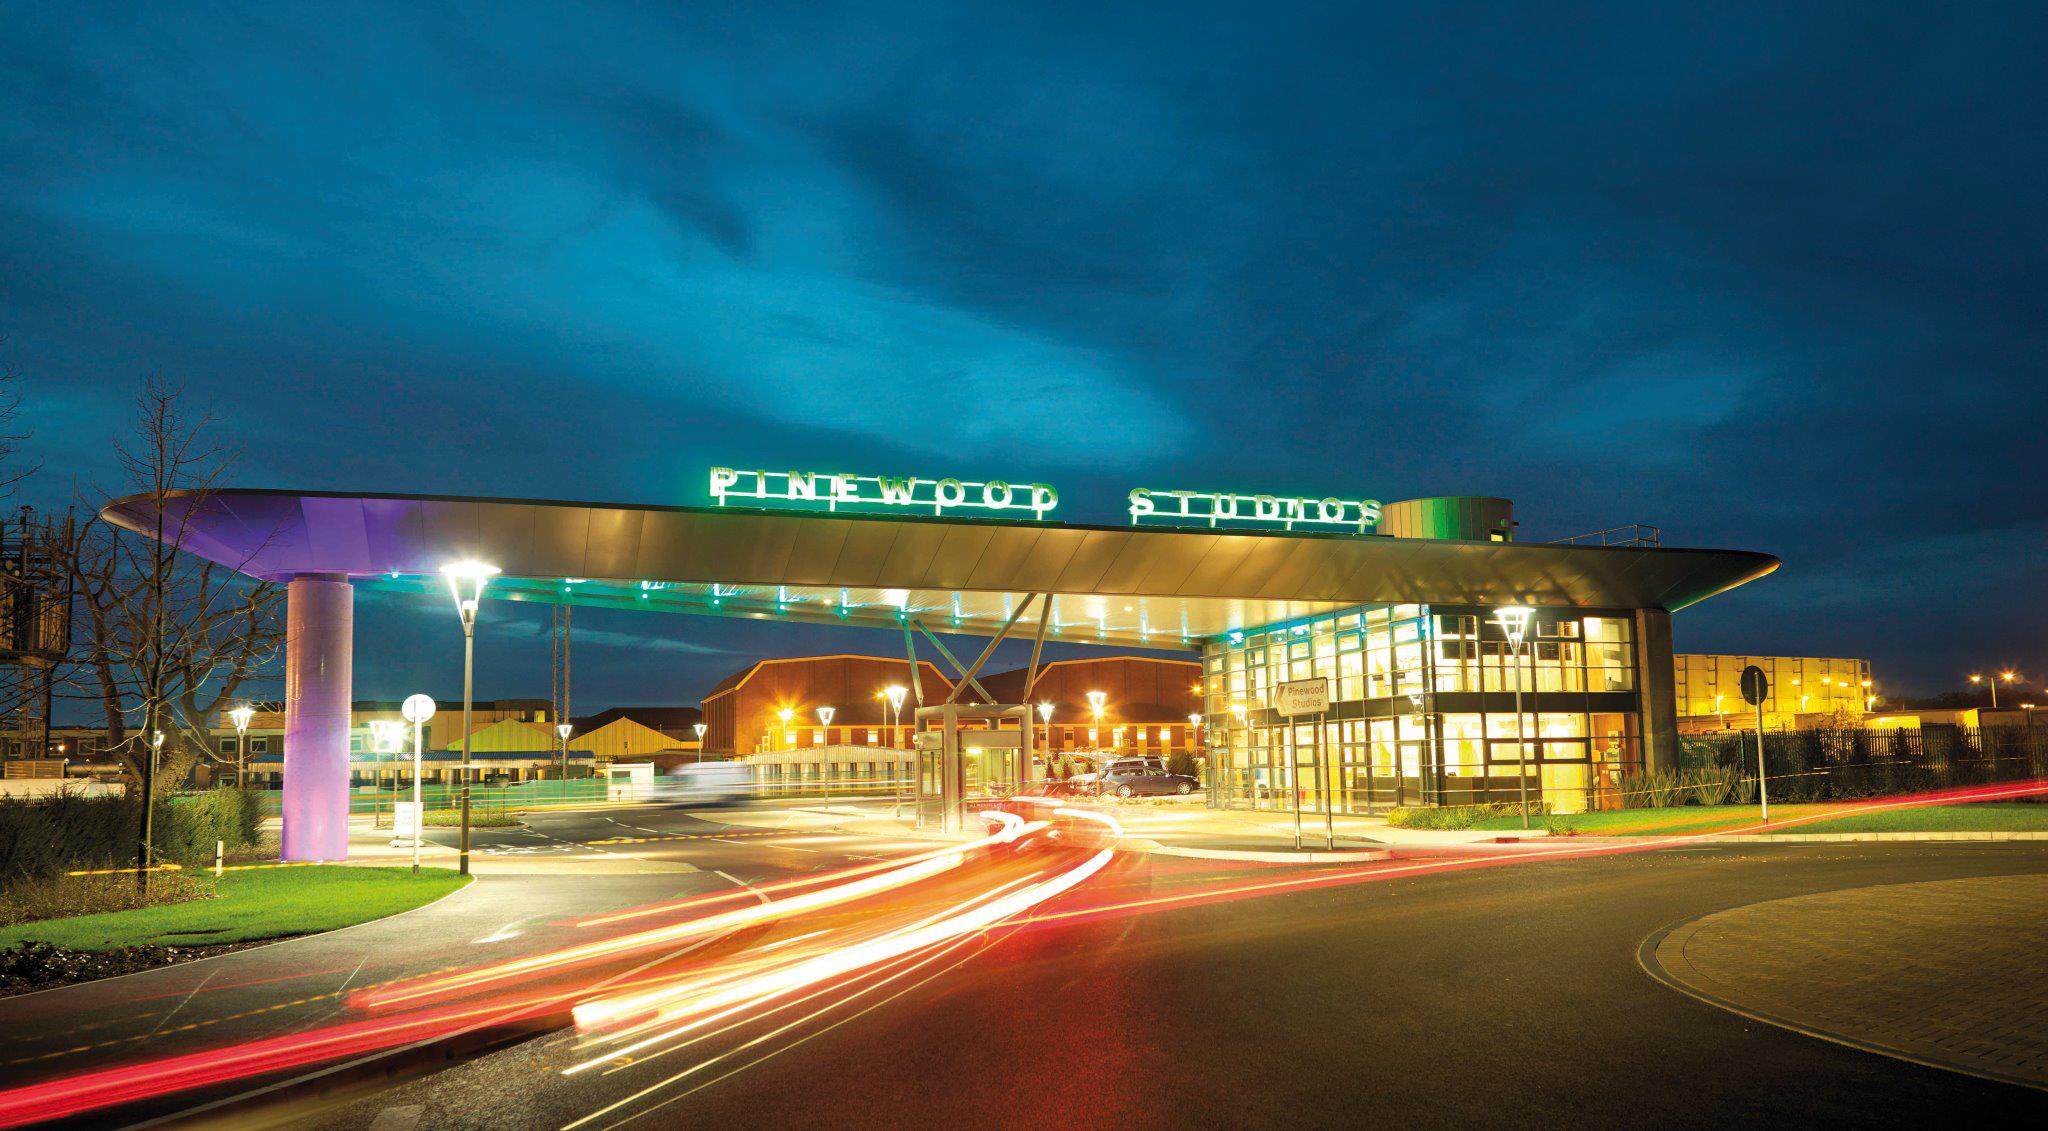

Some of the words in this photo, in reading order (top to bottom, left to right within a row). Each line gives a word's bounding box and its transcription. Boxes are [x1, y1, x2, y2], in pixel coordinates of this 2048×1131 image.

[710, 466, 1059, 512] PINEWOOD
[1128, 487, 1383, 526] STUDIOS
[1288, 683, 1325, 697] Pinewood
[1292, 698, 1322, 709] Studios
